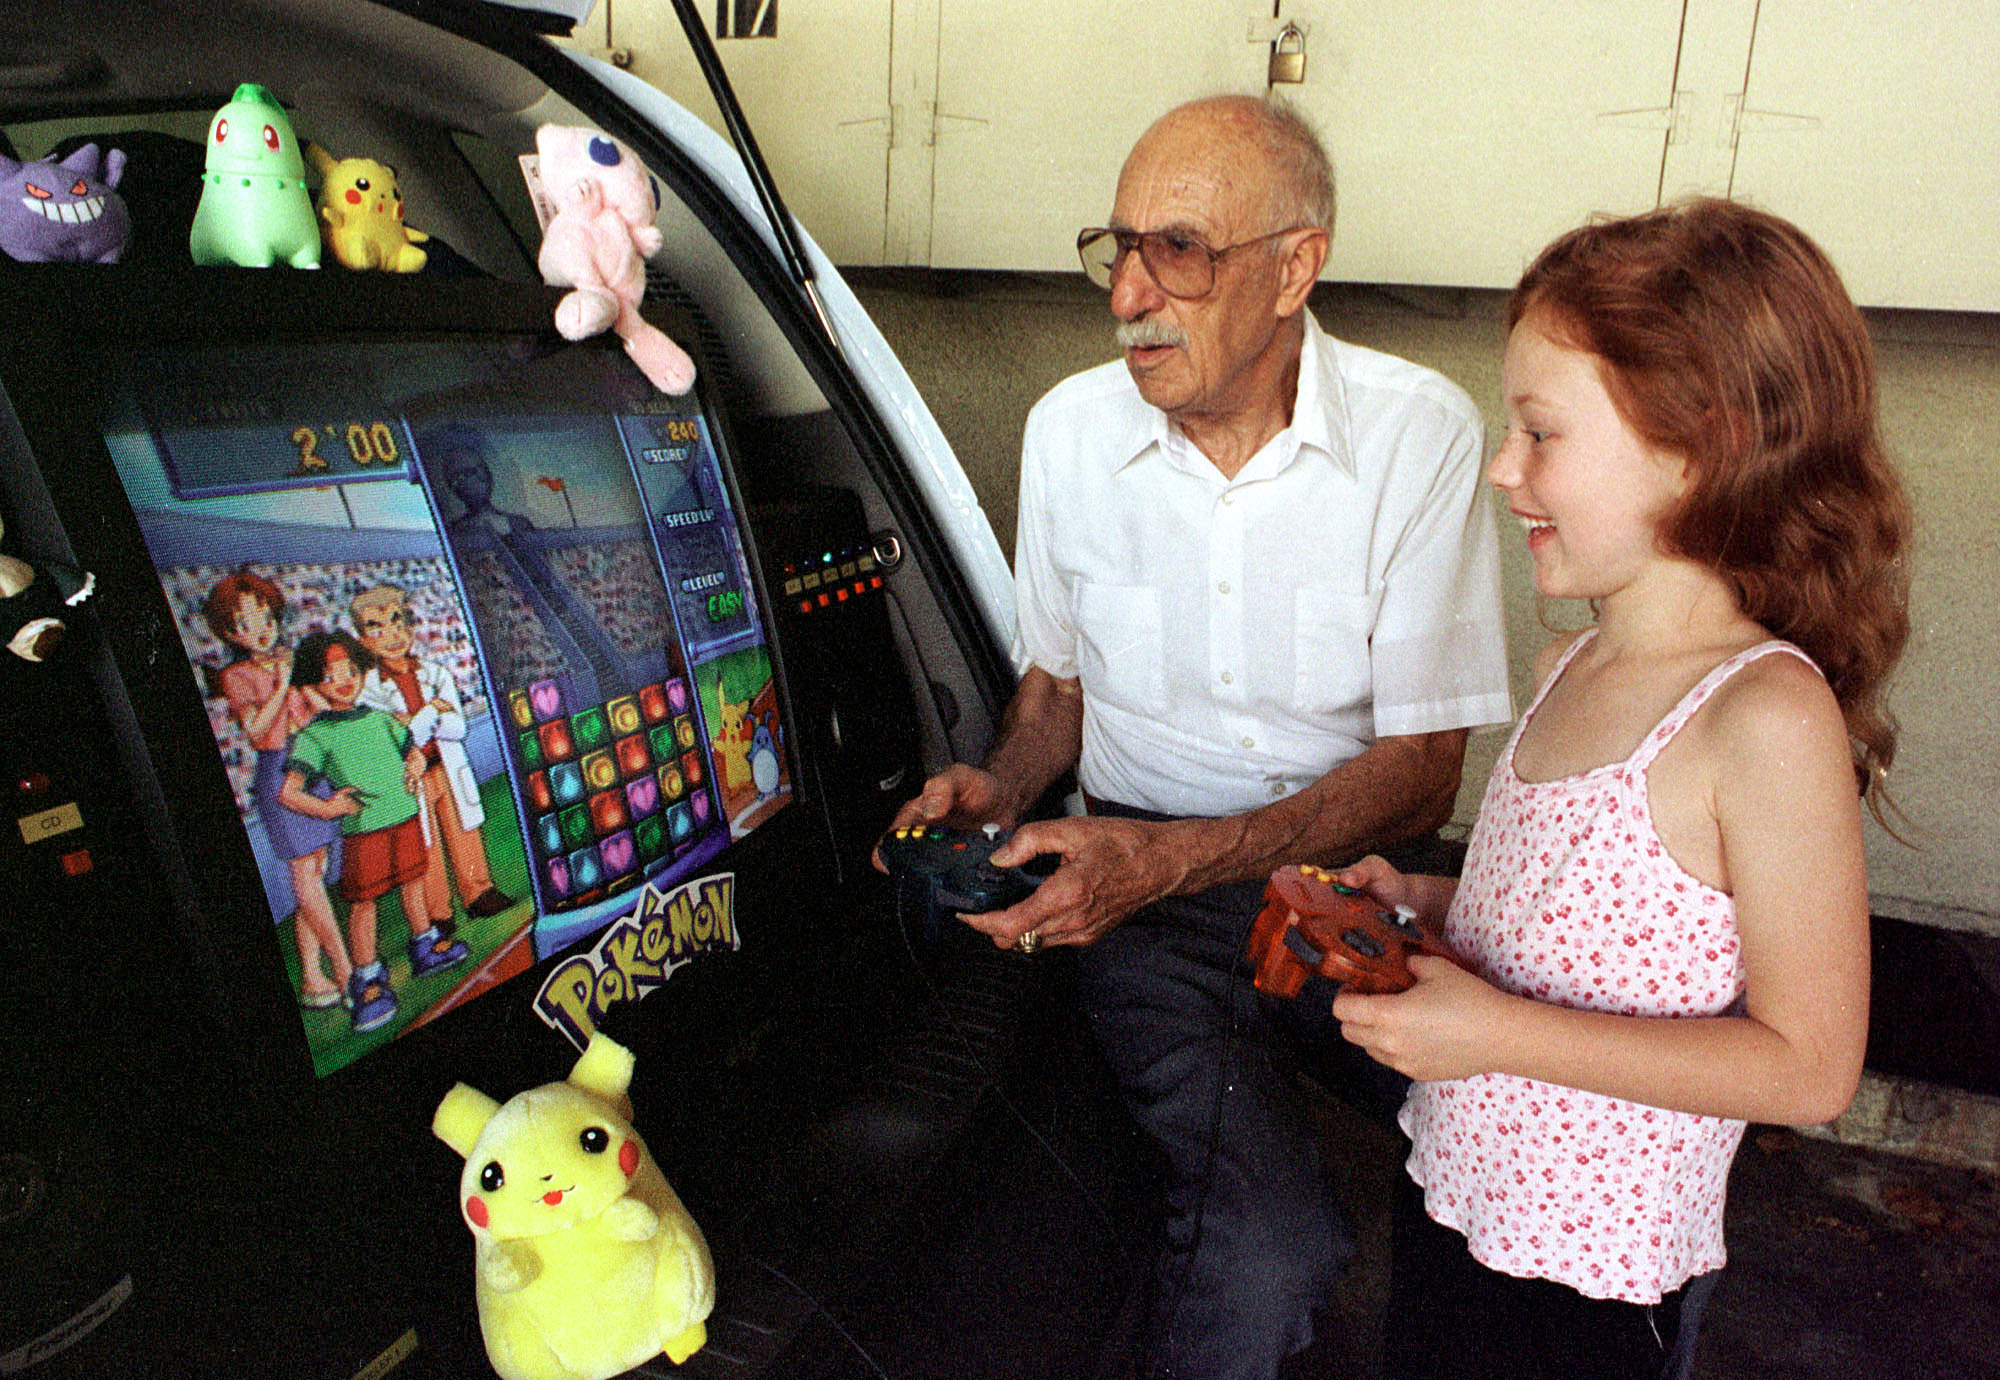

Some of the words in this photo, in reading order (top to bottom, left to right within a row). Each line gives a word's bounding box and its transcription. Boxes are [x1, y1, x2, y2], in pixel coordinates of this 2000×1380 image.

[667, 420, 699, 441] 240
[649, 448, 683, 463] SCORE
[665, 510, 699, 528] SPEED
[688, 573, 720, 591] LEVEL
[708, 590, 743, 621] EASY
[41, 815, 61, 830] CD
